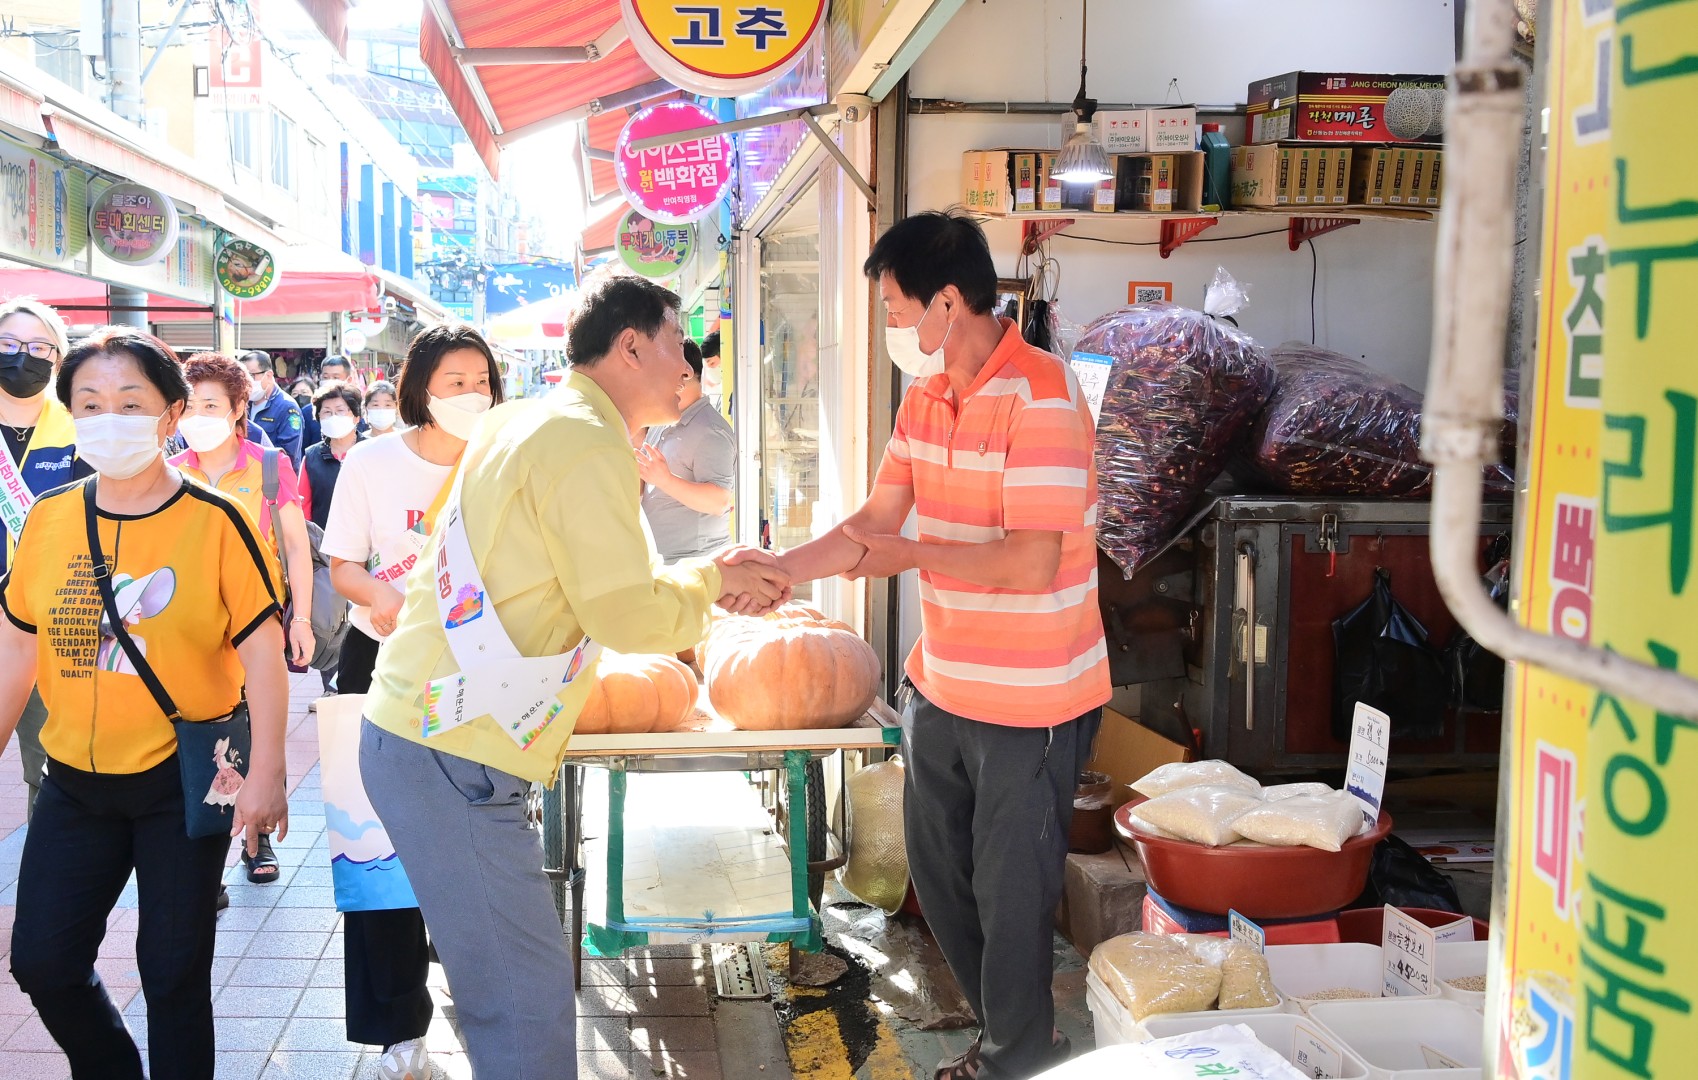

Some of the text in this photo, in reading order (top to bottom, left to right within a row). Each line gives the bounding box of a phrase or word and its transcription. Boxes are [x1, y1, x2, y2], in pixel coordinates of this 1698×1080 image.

[672, 8, 787, 50] 고추
[1350, 81, 1370, 89] JANG
[1372, 81, 1398, 89] CHEON
[1400, 81, 1418, 90] MUSK
[1419, 82, 1445, 90] MELON
[1334, 106, 1376, 130] 메론
[639, 163, 718, 193] 할인 백화점
[663, 195, 697, 205] 반여직영점
[95, 211, 165, 234] 도매회센터
[621, 230, 689, 250] 무지개아동복
[223, 275, 271, 297] 783-9887
[55, 588, 87, 596] LEGENDS
[62, 597, 103, 605] ARE BORN
[48, 607, 100, 616] IN OCTOBER
[52, 618, 98, 626] BROOKLYN
[63, 627, 97, 637] LEAGUE
[51, 638, 97, 647] LEGENDARY
[55, 648, 96, 658] TEAM CO
[72, 658, 94, 667] TEAM
[61, 669, 93, 679] QUALITY
[455, 688, 464, 722] 해운대구
[1298, 1049, 1308, 1062] 품명
